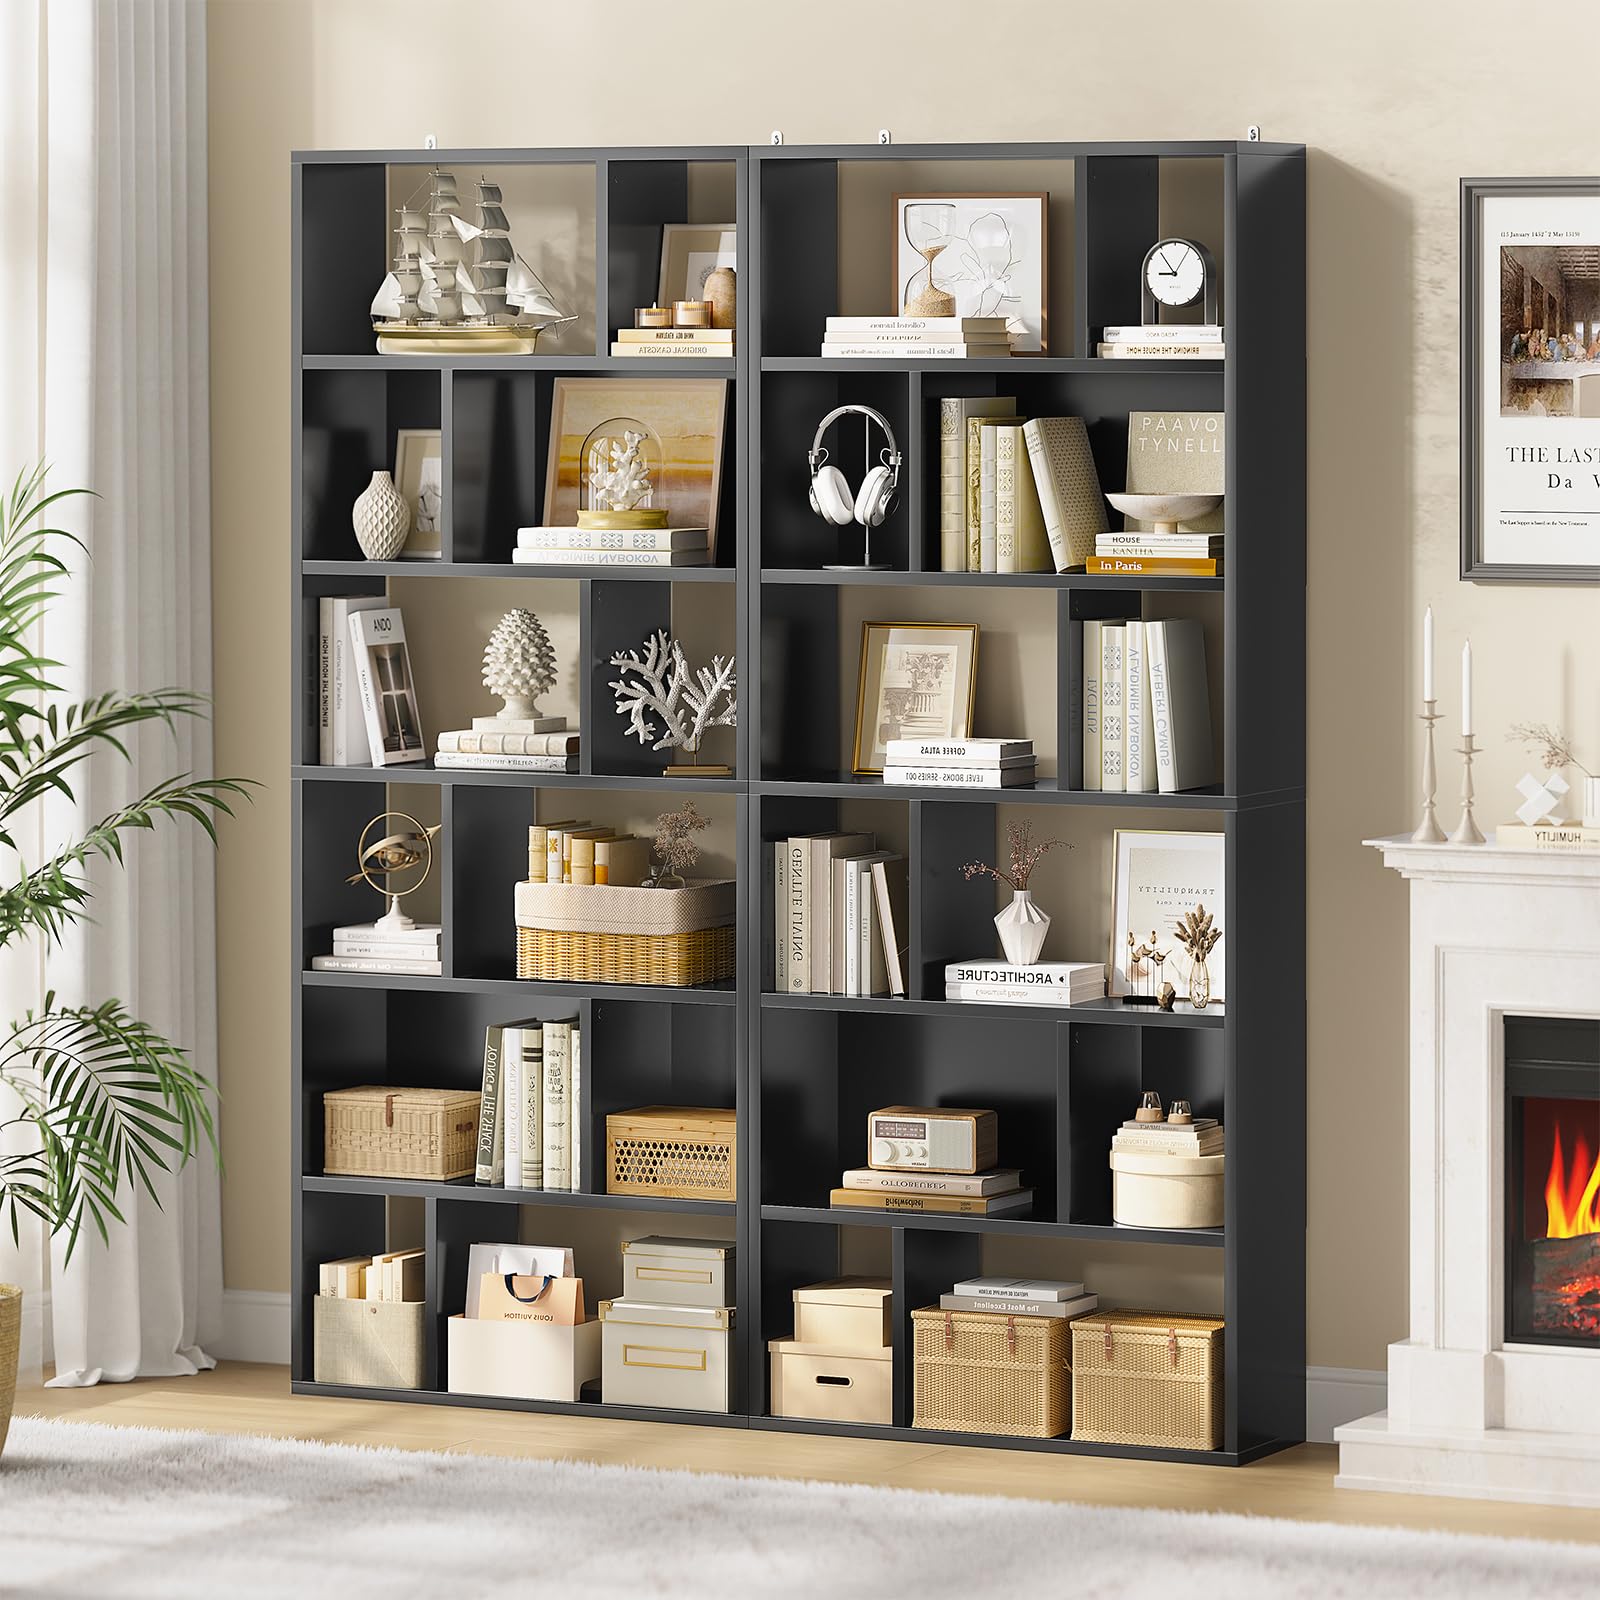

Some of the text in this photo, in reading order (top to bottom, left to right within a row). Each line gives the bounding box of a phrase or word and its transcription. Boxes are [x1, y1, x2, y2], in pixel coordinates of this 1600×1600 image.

[1142, 417, 1217, 432] PAAVO
[1138, 437, 1221, 453] TYNELL
[1506, 446, 1548, 462] THE
[1548, 473, 1573, 488] Da
[1100, 561, 1142, 571] In Paris
[373, 618, 392, 632] ANDO
